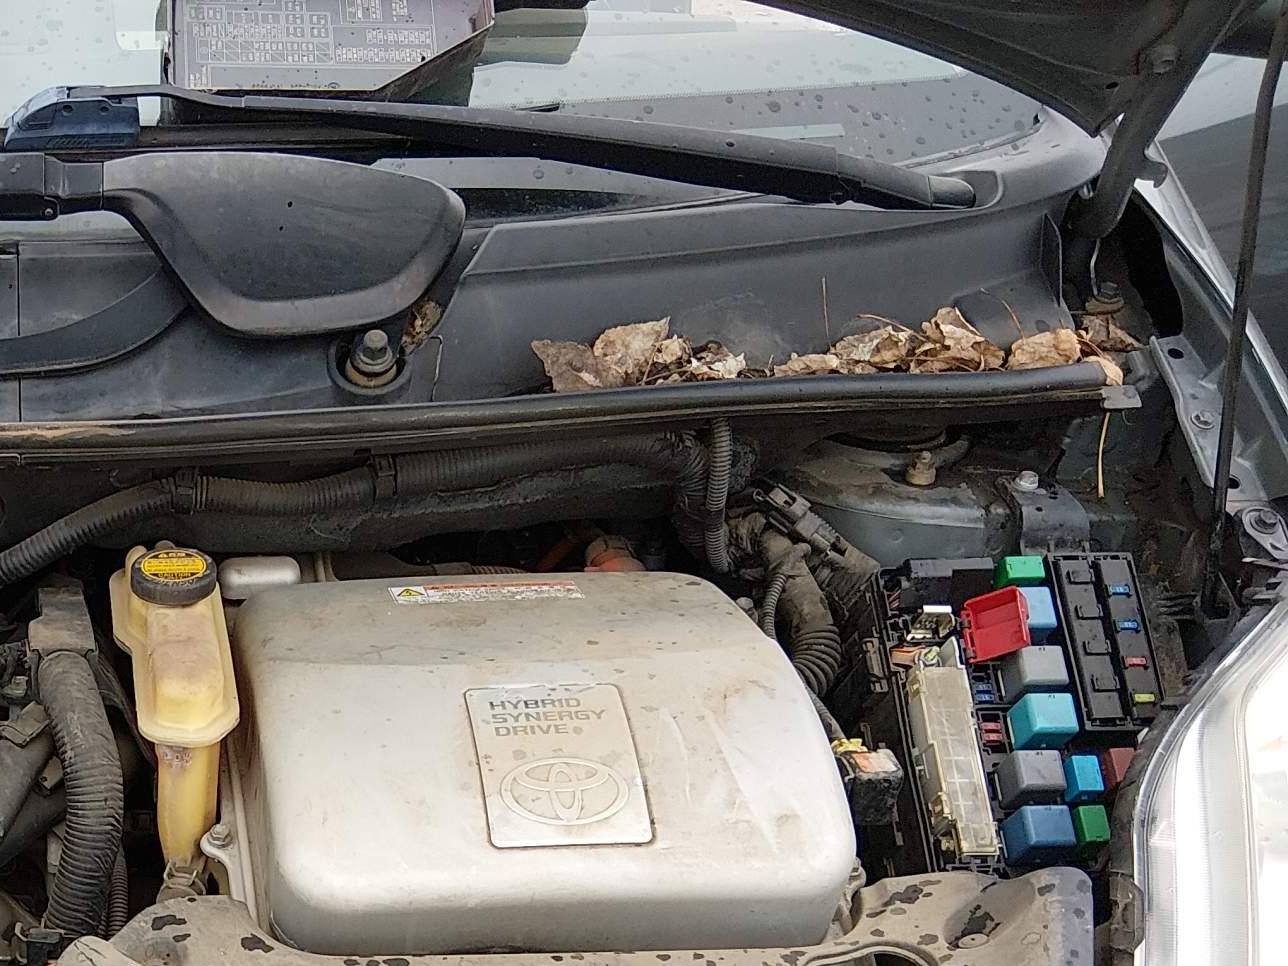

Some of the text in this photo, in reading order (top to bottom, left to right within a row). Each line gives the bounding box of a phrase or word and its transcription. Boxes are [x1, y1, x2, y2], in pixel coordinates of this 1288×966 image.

[158, 571, 192, 579] CAUTION
[488, 697, 582, 711] HYBRID
[491, 709, 605, 724] SYNERGY
[494, 723, 569, 737] DRIVE
